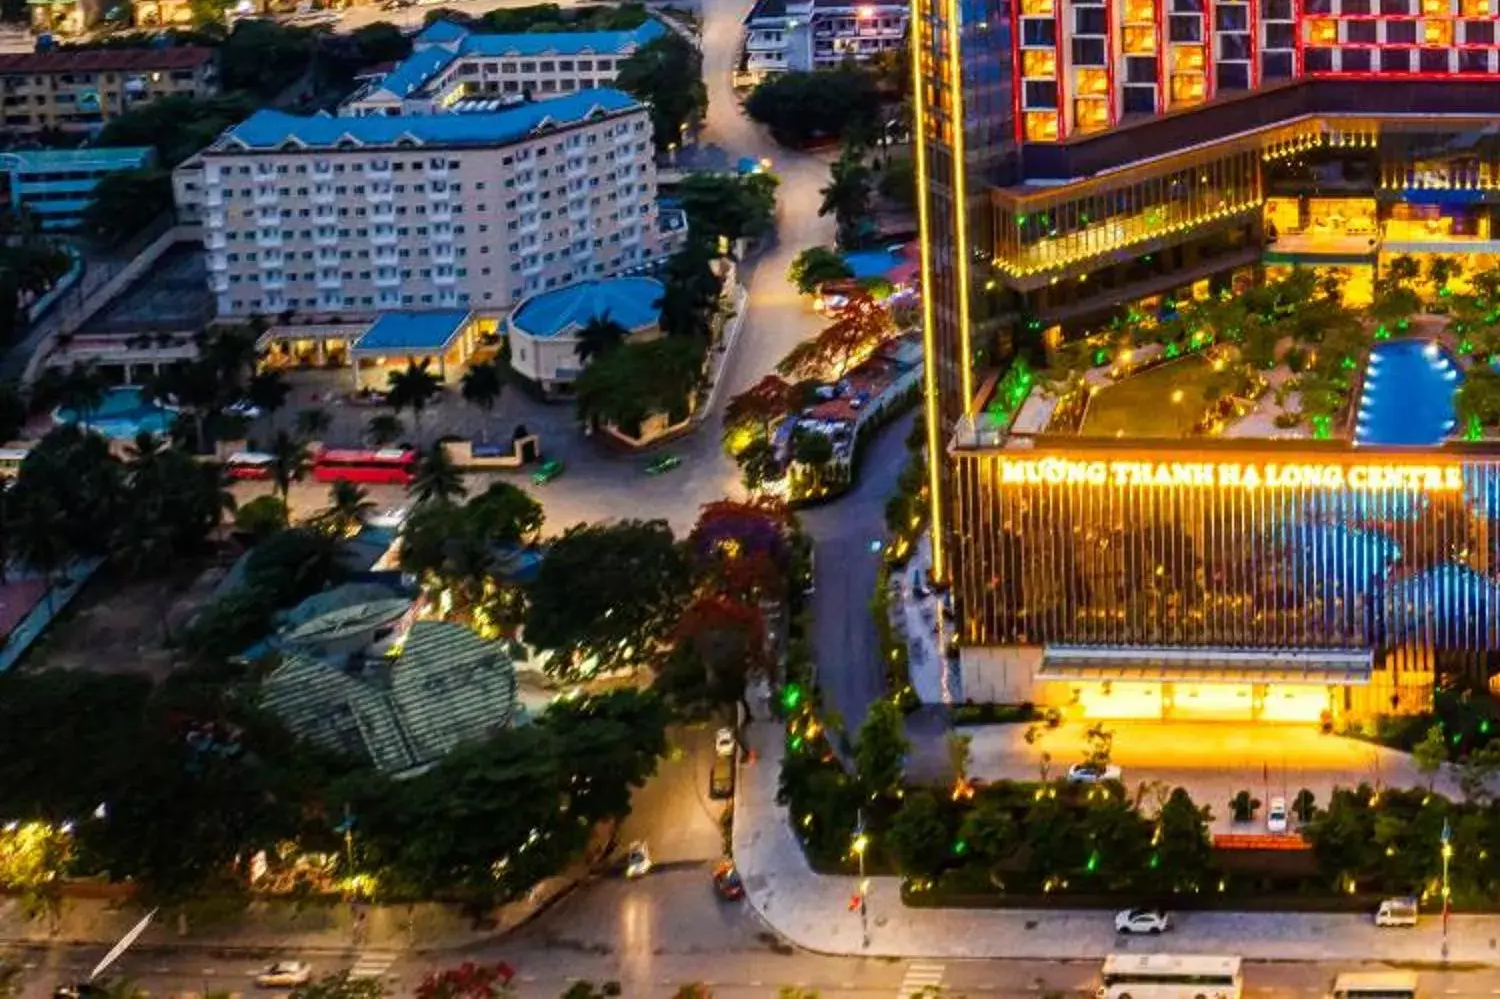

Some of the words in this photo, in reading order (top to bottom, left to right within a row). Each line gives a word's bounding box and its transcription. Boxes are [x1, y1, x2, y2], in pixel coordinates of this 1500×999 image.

[1001, 457, 1108, 486] MƯỜNG
[1111, 461, 1214, 487] THANH
[1218, 463, 1260, 490] HẠ
[1264, 463, 1345, 489] LONG
[1347, 464, 1462, 490] CENTRE
